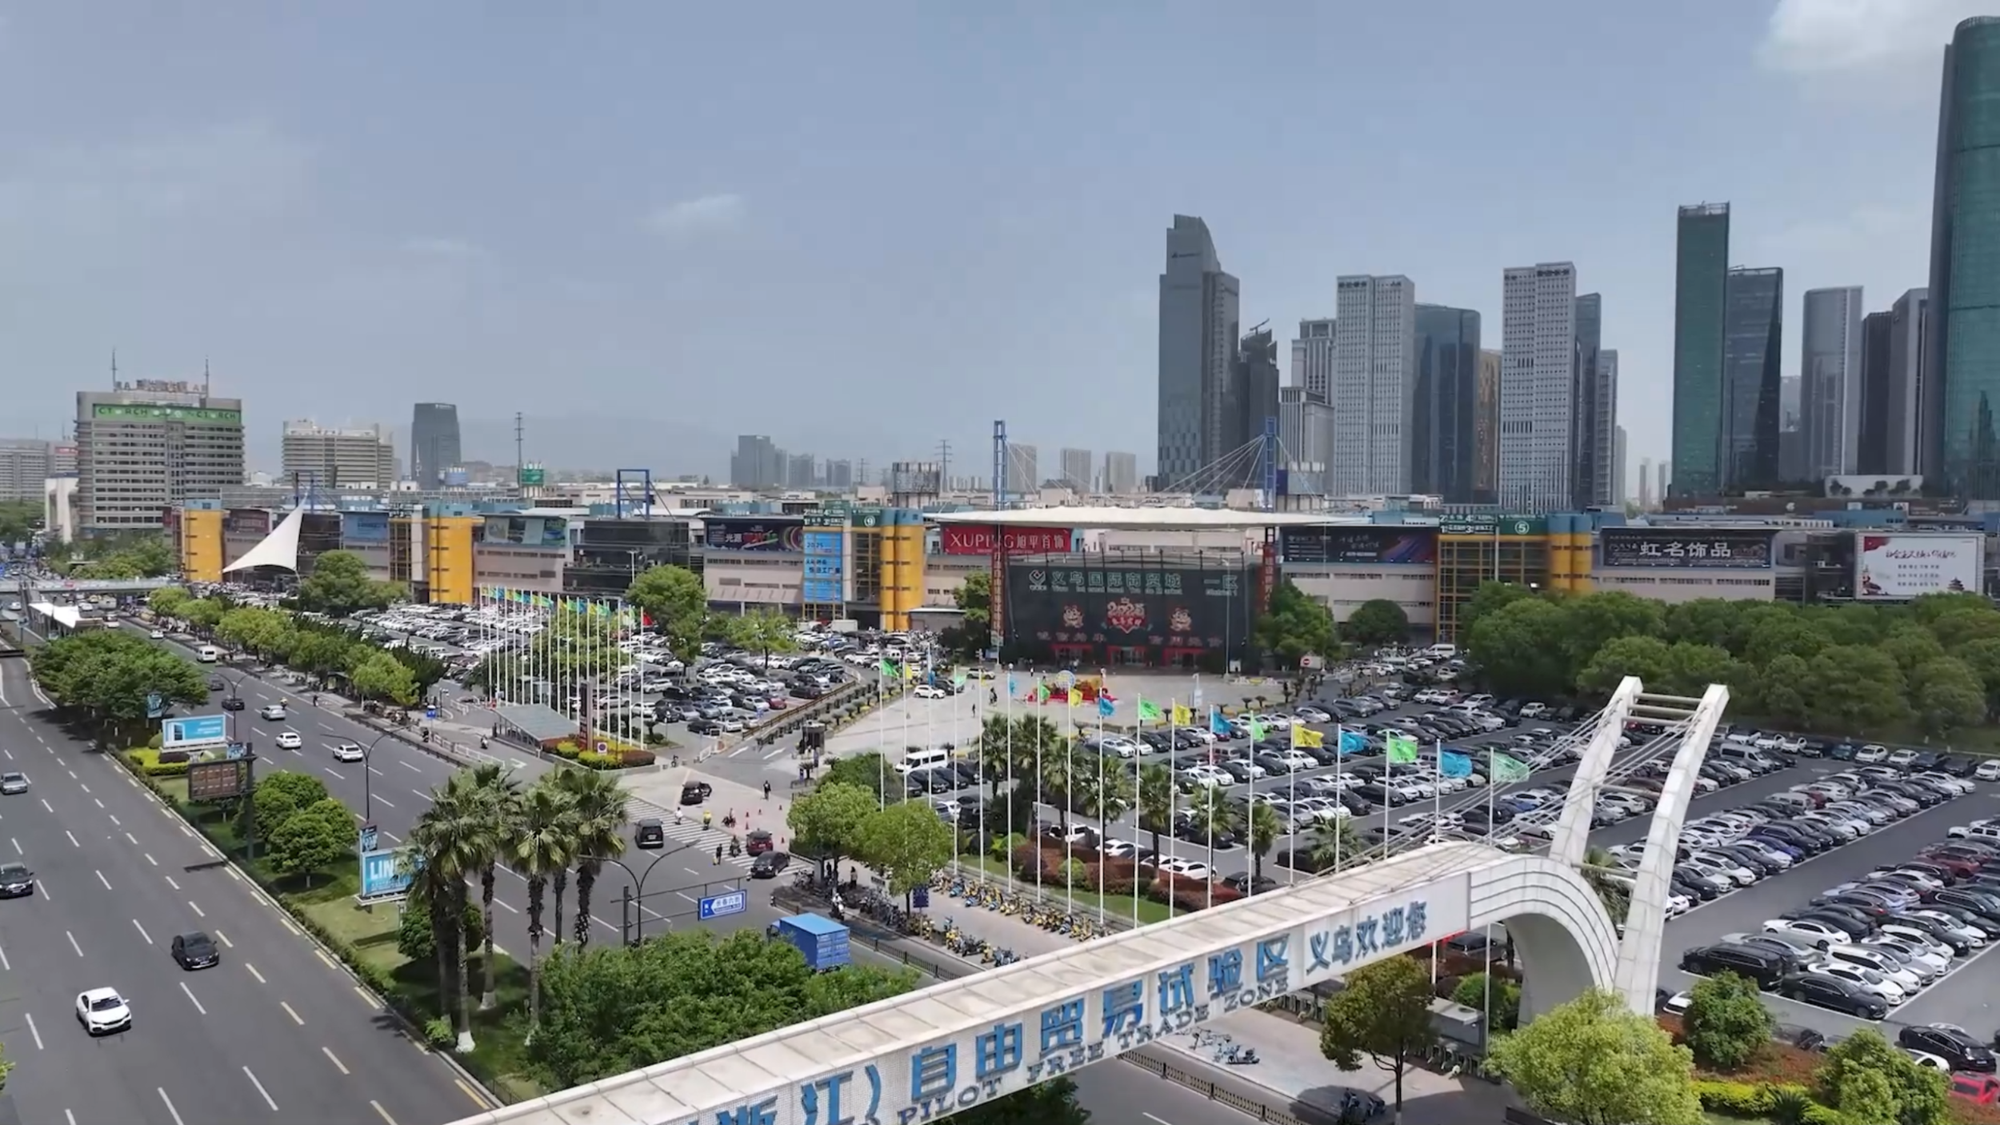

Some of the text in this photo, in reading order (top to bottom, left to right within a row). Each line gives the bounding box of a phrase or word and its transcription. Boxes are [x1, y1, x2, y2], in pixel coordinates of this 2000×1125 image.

[1016, 533, 1065, 549] 旭平首饰
[1639, 541, 1732, 558] 虹名饰品
[1052, 571, 1238, 589] 义乌国际商贸城 一区
[1306, 901, 1428, 975] 义乌欢迎您
[897, 975, 1290, 1125] PILOT FREE TRADE ZONE
